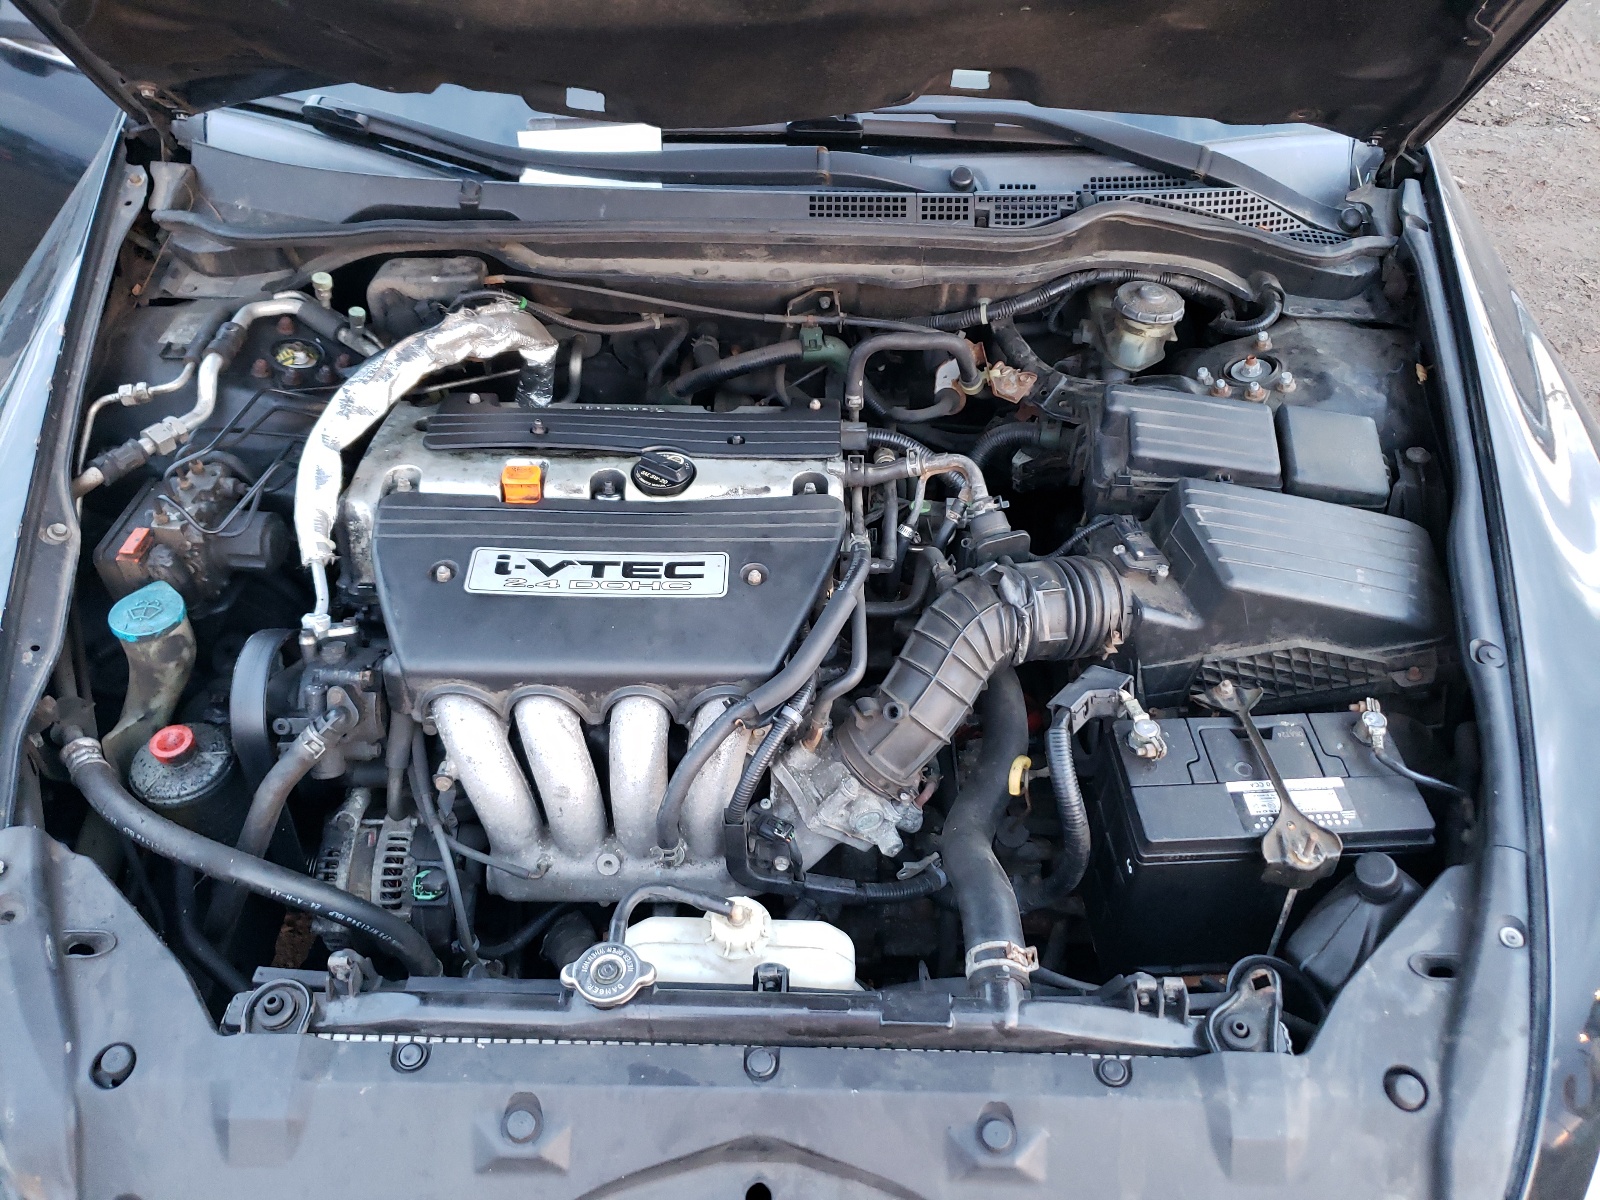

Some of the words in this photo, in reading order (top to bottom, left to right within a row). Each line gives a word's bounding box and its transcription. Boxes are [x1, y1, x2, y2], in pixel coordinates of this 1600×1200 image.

[495, 554, 705, 579] i-VTEC
[504, 578, 560, 589] 2.4
[569, 580, 692, 591] DOHC
[607, 947, 624, 955] OPEN
[588, 983, 625, 995] DANGER
